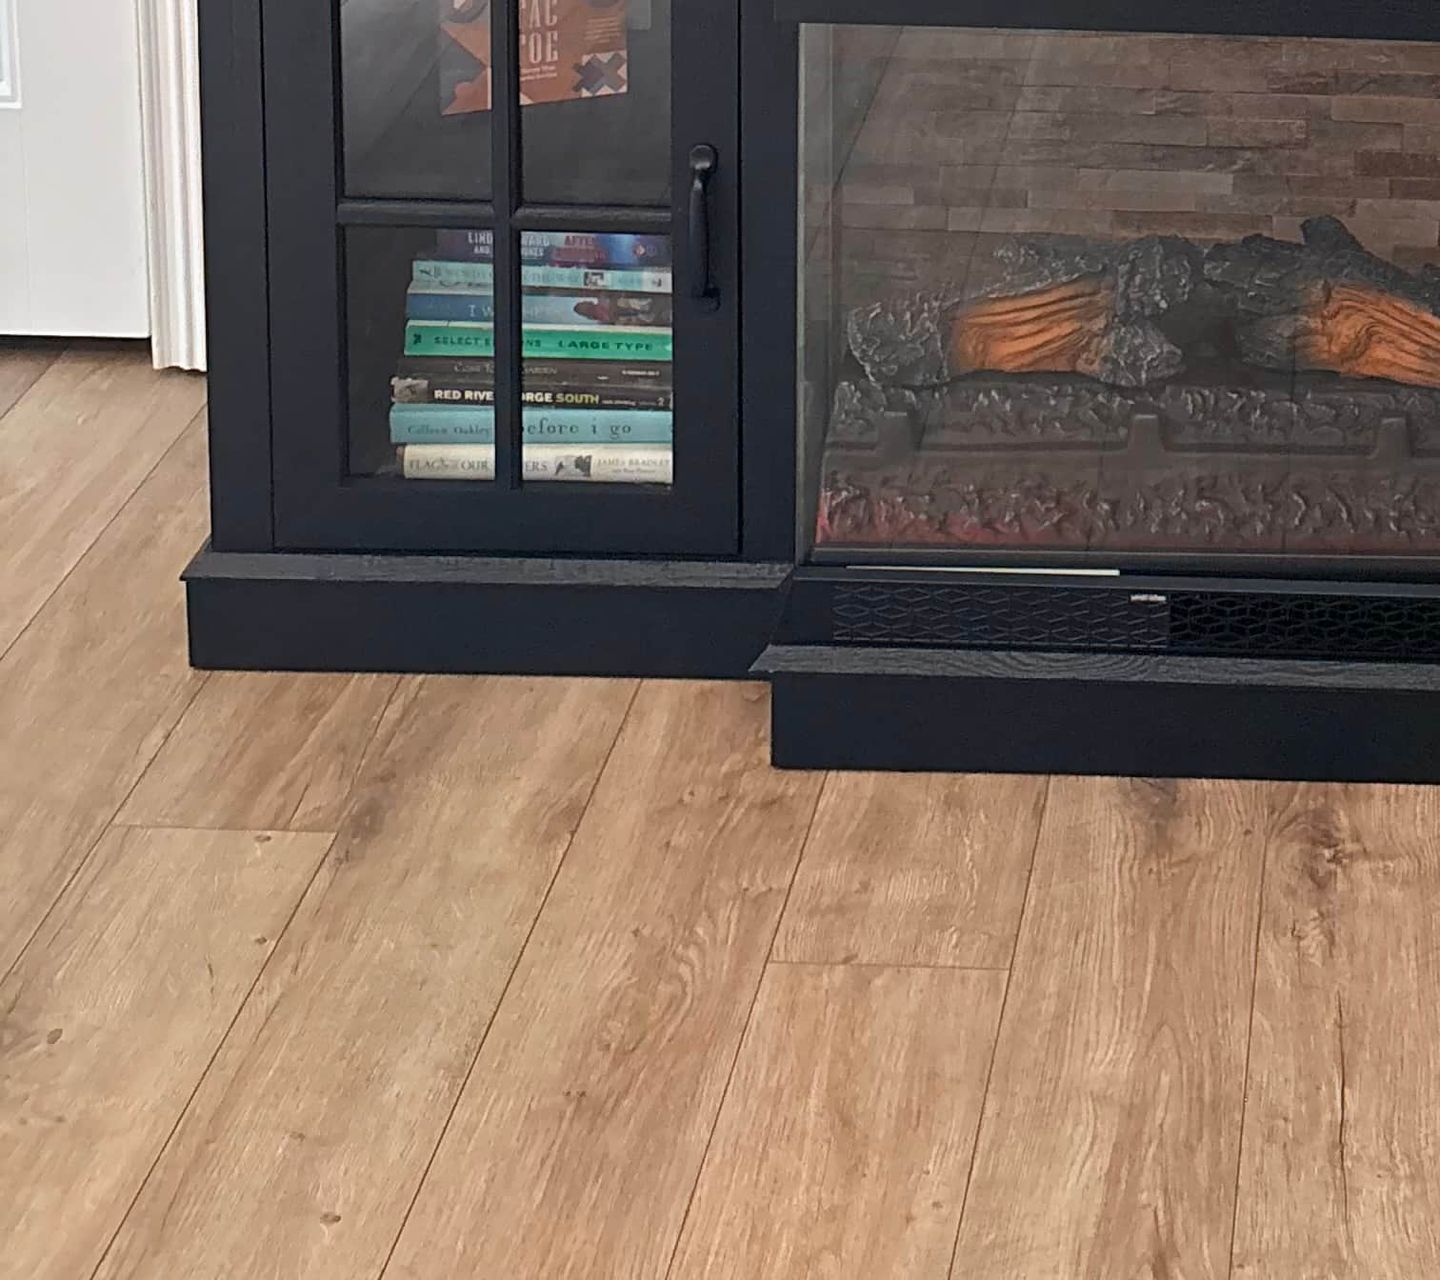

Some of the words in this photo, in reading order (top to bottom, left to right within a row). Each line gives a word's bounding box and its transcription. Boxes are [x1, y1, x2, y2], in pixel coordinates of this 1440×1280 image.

[519, 30, 558, 64] OE
[434, 335, 481, 346] SELECT
[557, 339, 611, 350] LARGE
[614, 341, 655, 351] TYPE
[434, 389, 462, 400] RED
[464, 390, 495, 401] RIVE
[555, 393, 600, 405] SOUTH
[521, 416, 580, 436] efore
[591, 416, 598, 435] i
[609, 423, 633, 441] go
